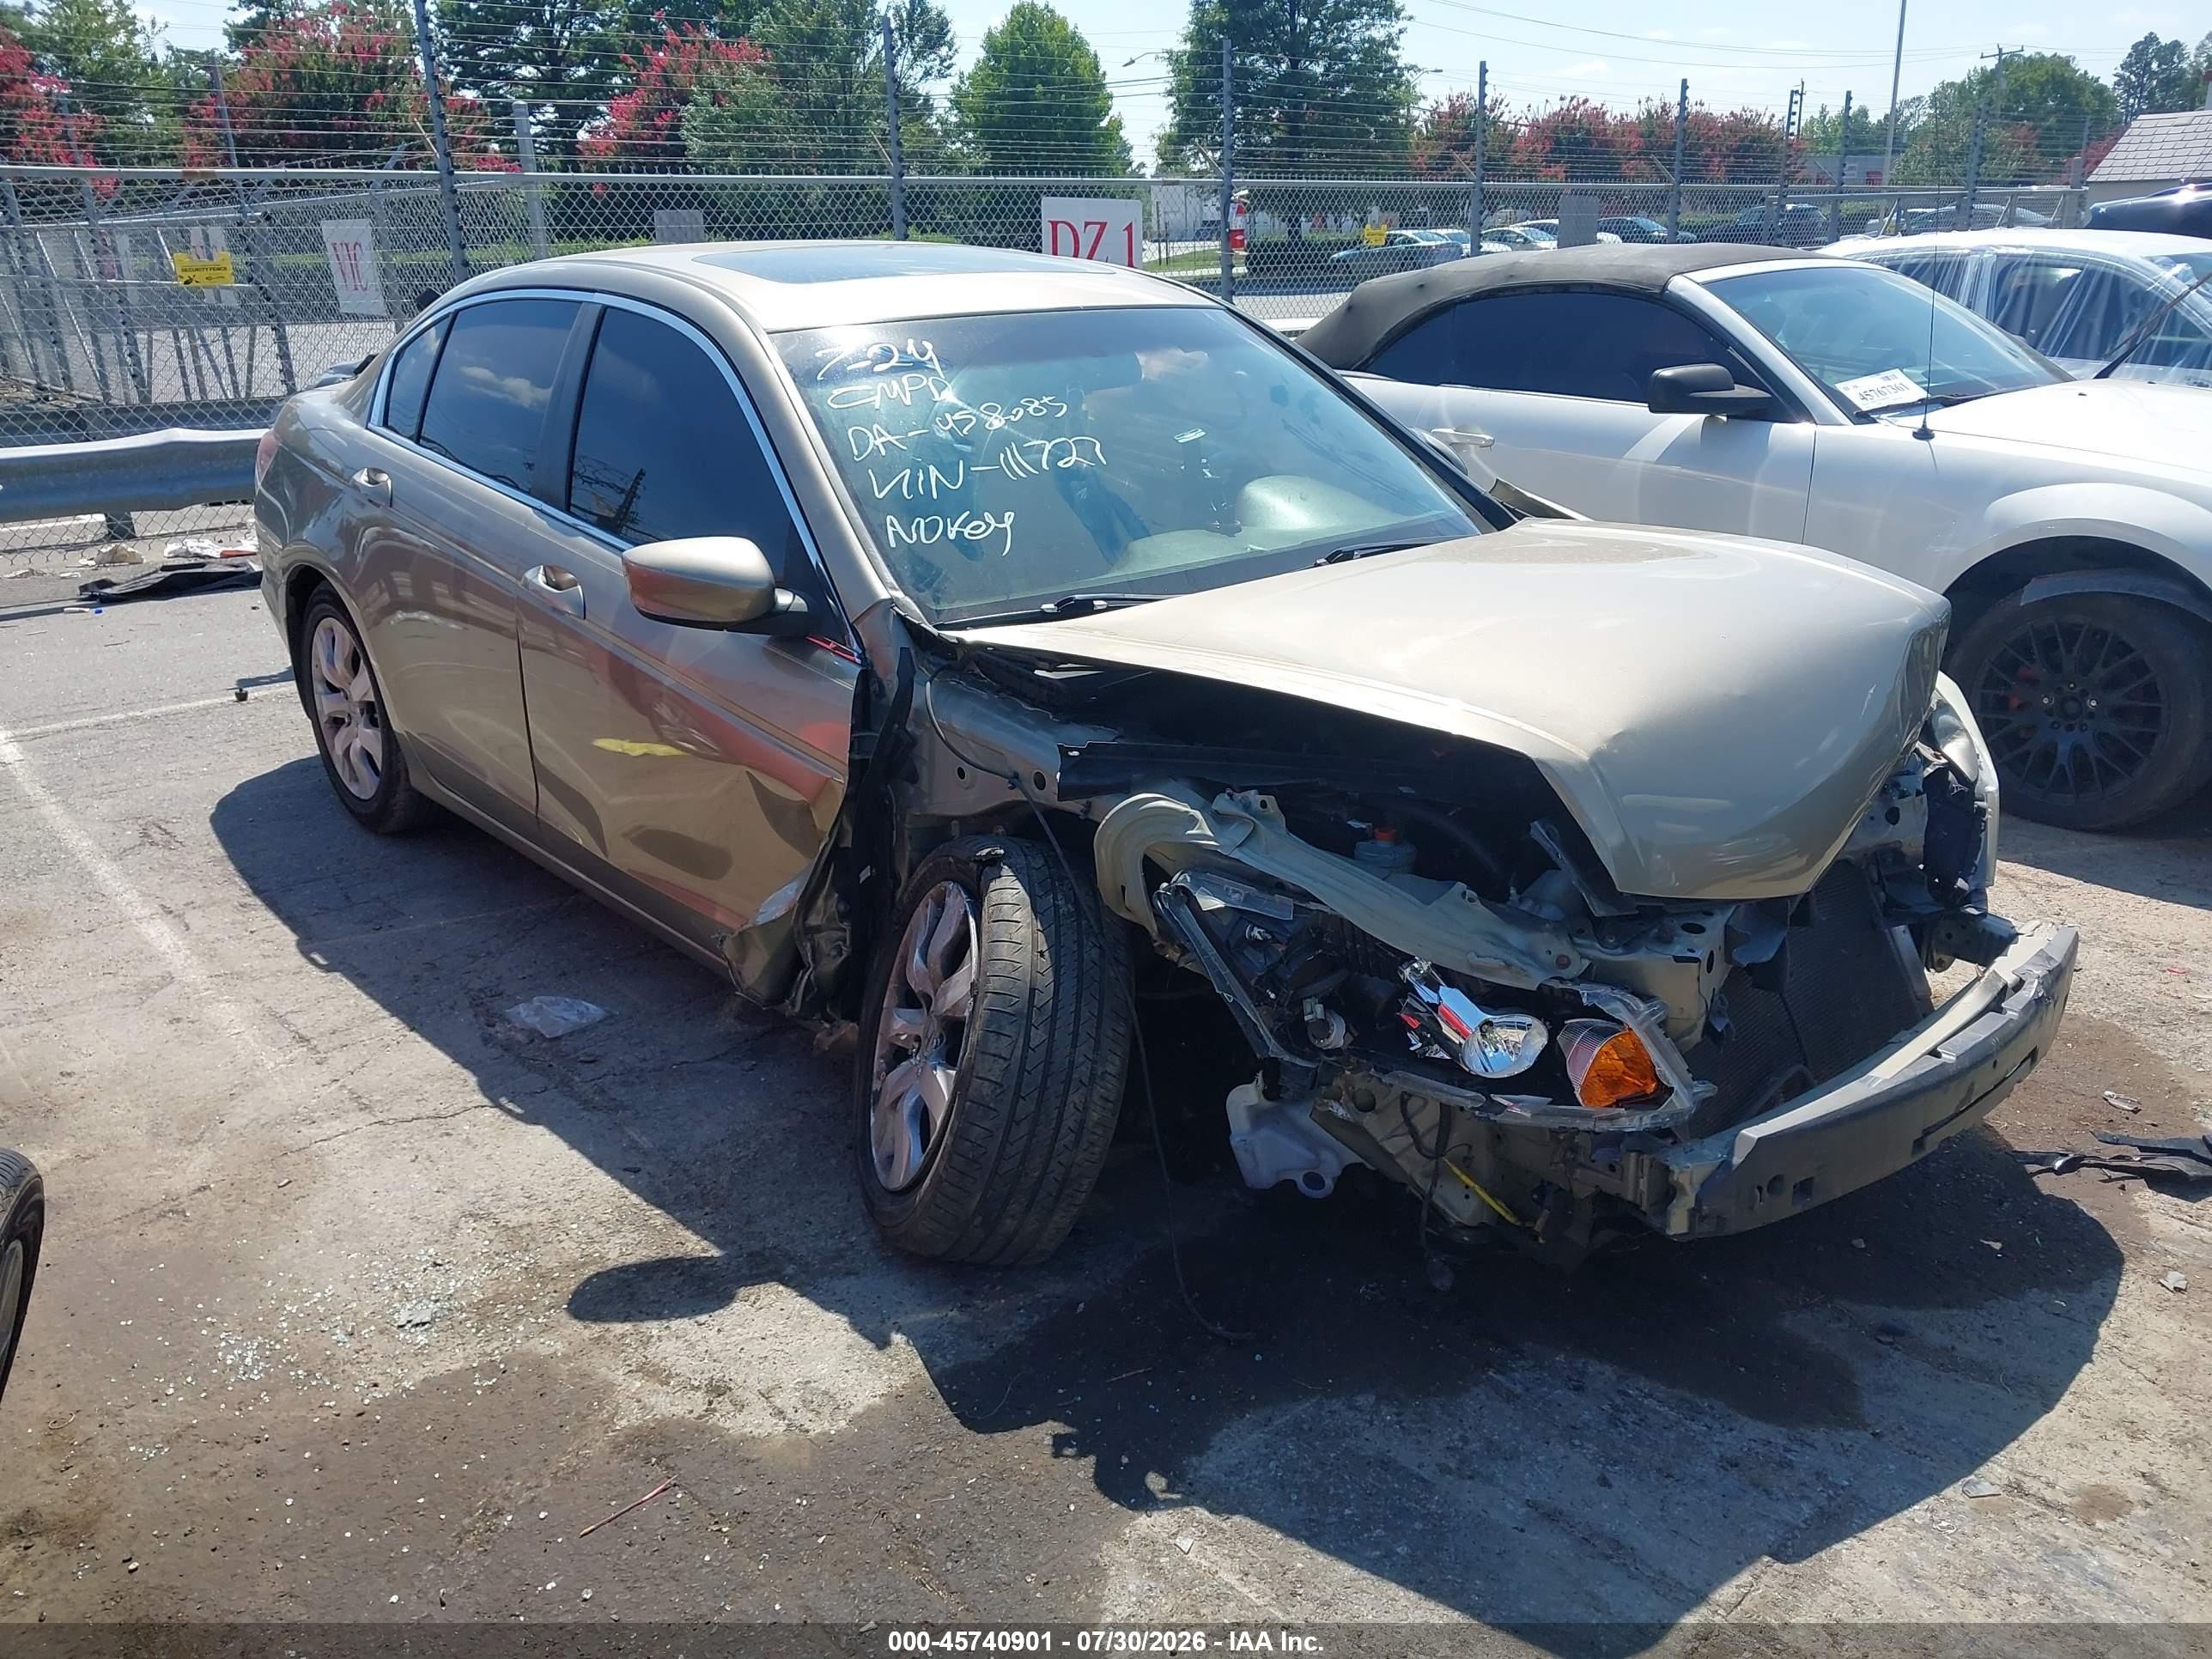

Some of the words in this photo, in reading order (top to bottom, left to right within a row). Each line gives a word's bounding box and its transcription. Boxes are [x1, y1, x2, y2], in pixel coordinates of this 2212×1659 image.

[1048, 220, 1109, 263] DZ
[1122, 221, 1133, 268] 1
[827, 374, 956, 410] CMPD
[1858, 383, 1910, 402] 45767361
